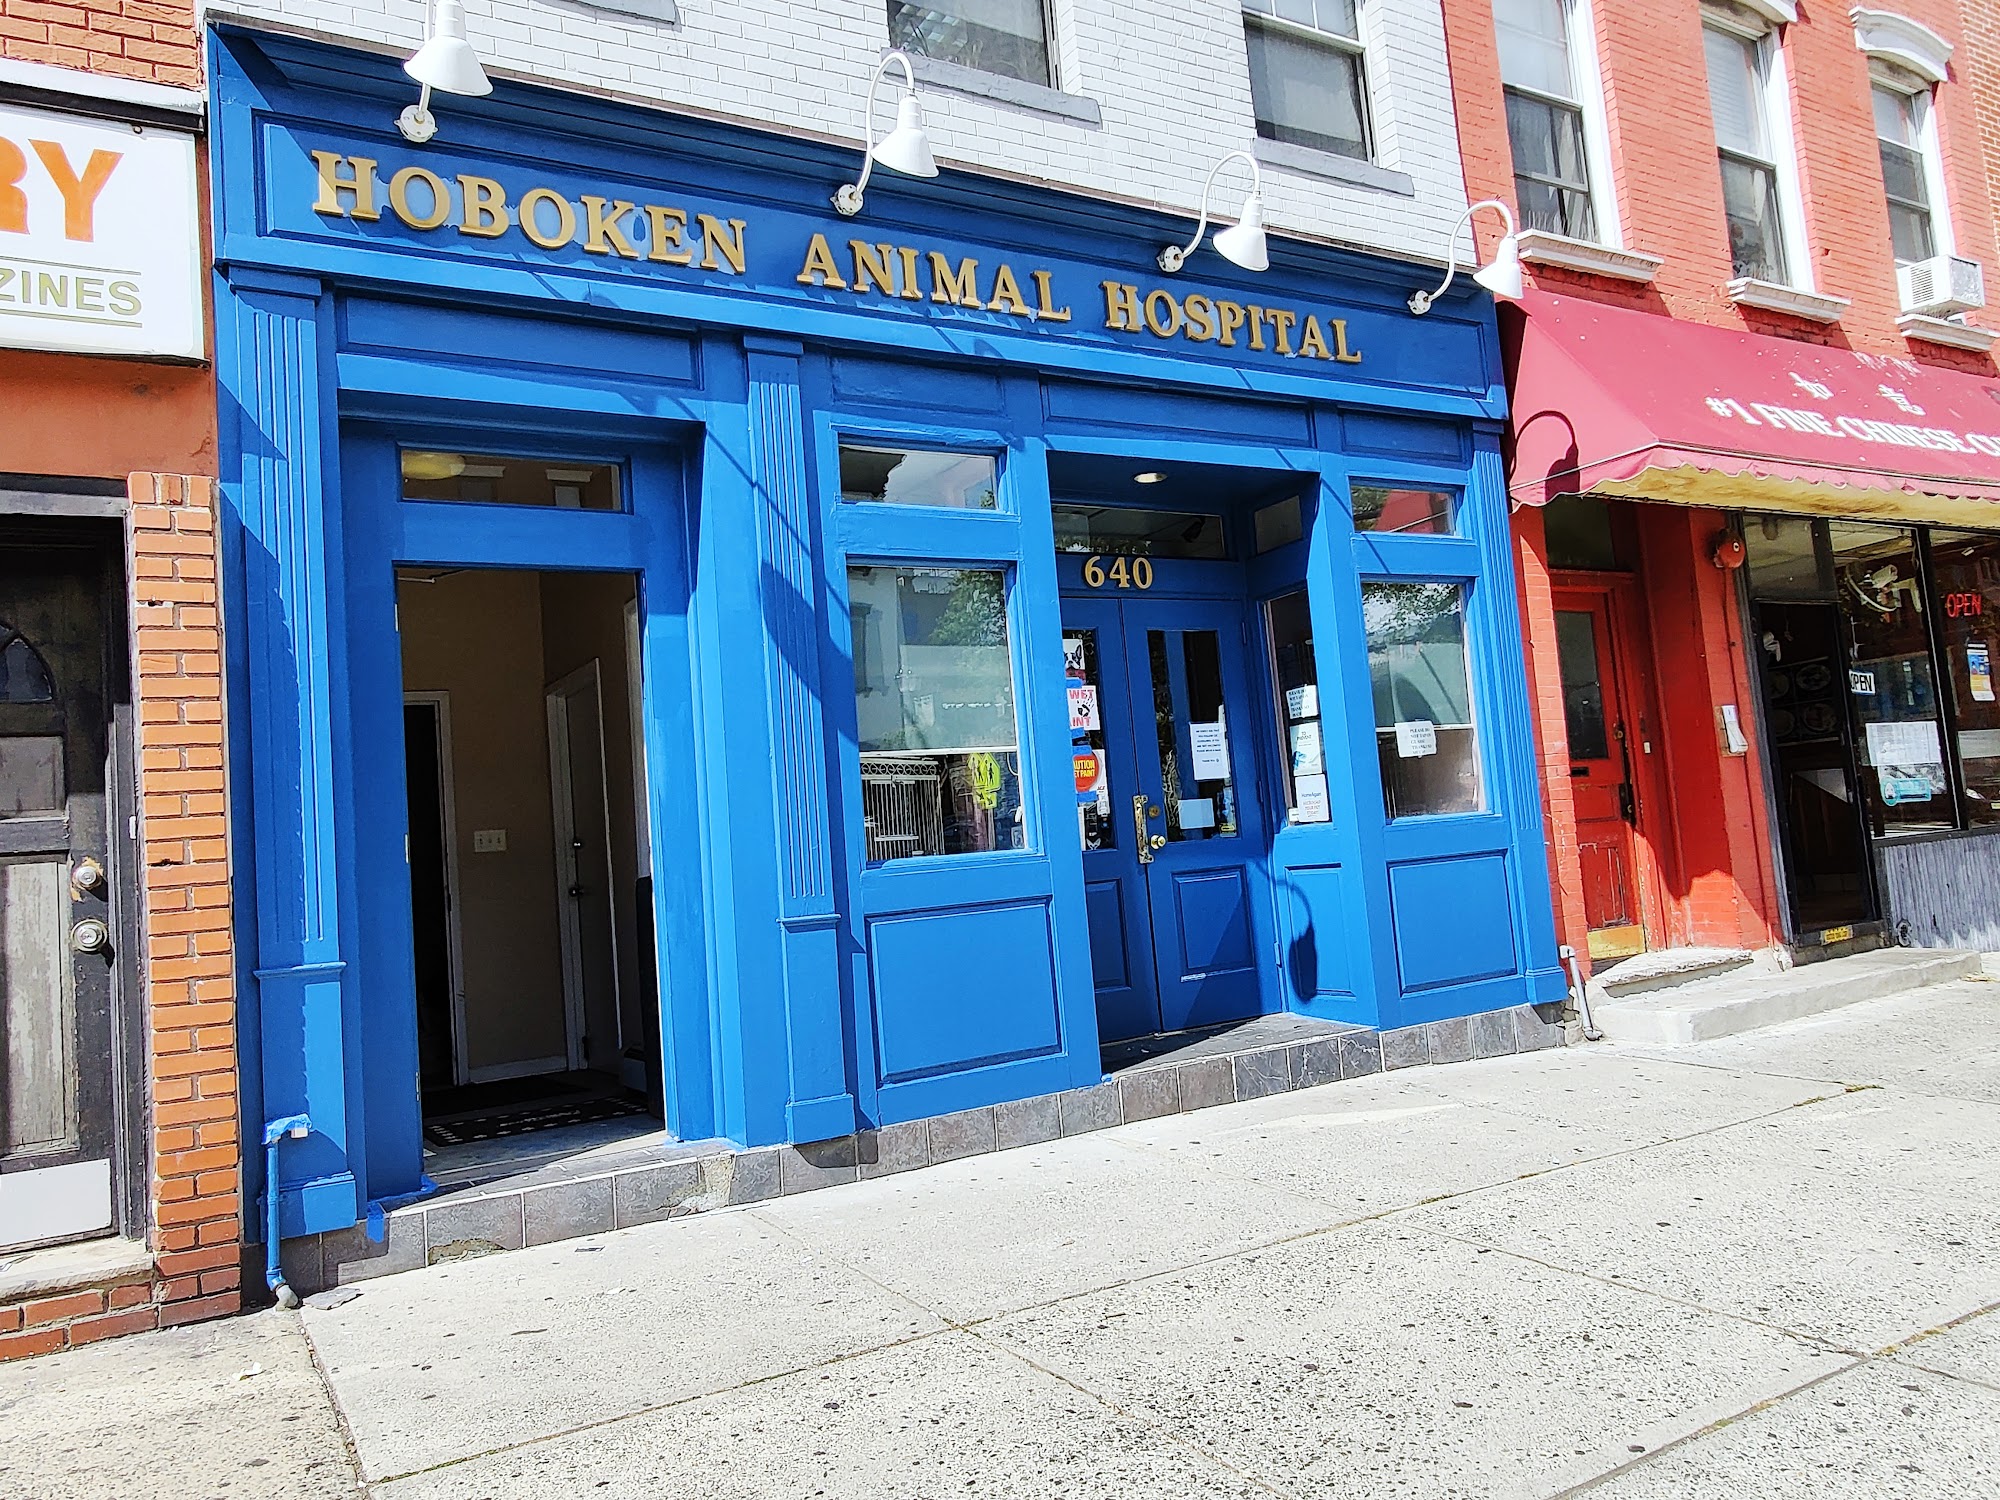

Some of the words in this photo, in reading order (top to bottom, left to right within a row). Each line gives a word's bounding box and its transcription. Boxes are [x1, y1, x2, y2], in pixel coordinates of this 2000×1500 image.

[311, 149, 746, 274] HOBOKEN
[796, 233, 1071, 322] ANIMAL
[1100, 280, 1361, 364] HOSPITAL
[1705, 397, 1762, 425] #1
[1749, 402, 1846, 437] FINE
[1836, 416, 1978, 454] CHINESE
[1084, 556, 1153, 589] 640
[1947, 594, 1982, 617] OPEN
[1850, 673, 1872, 691] OPEN
[1069, 689, 1094, 699] WET
[1070, 716, 1091, 727] INT
[1080, 769, 1095, 778] PAINT
